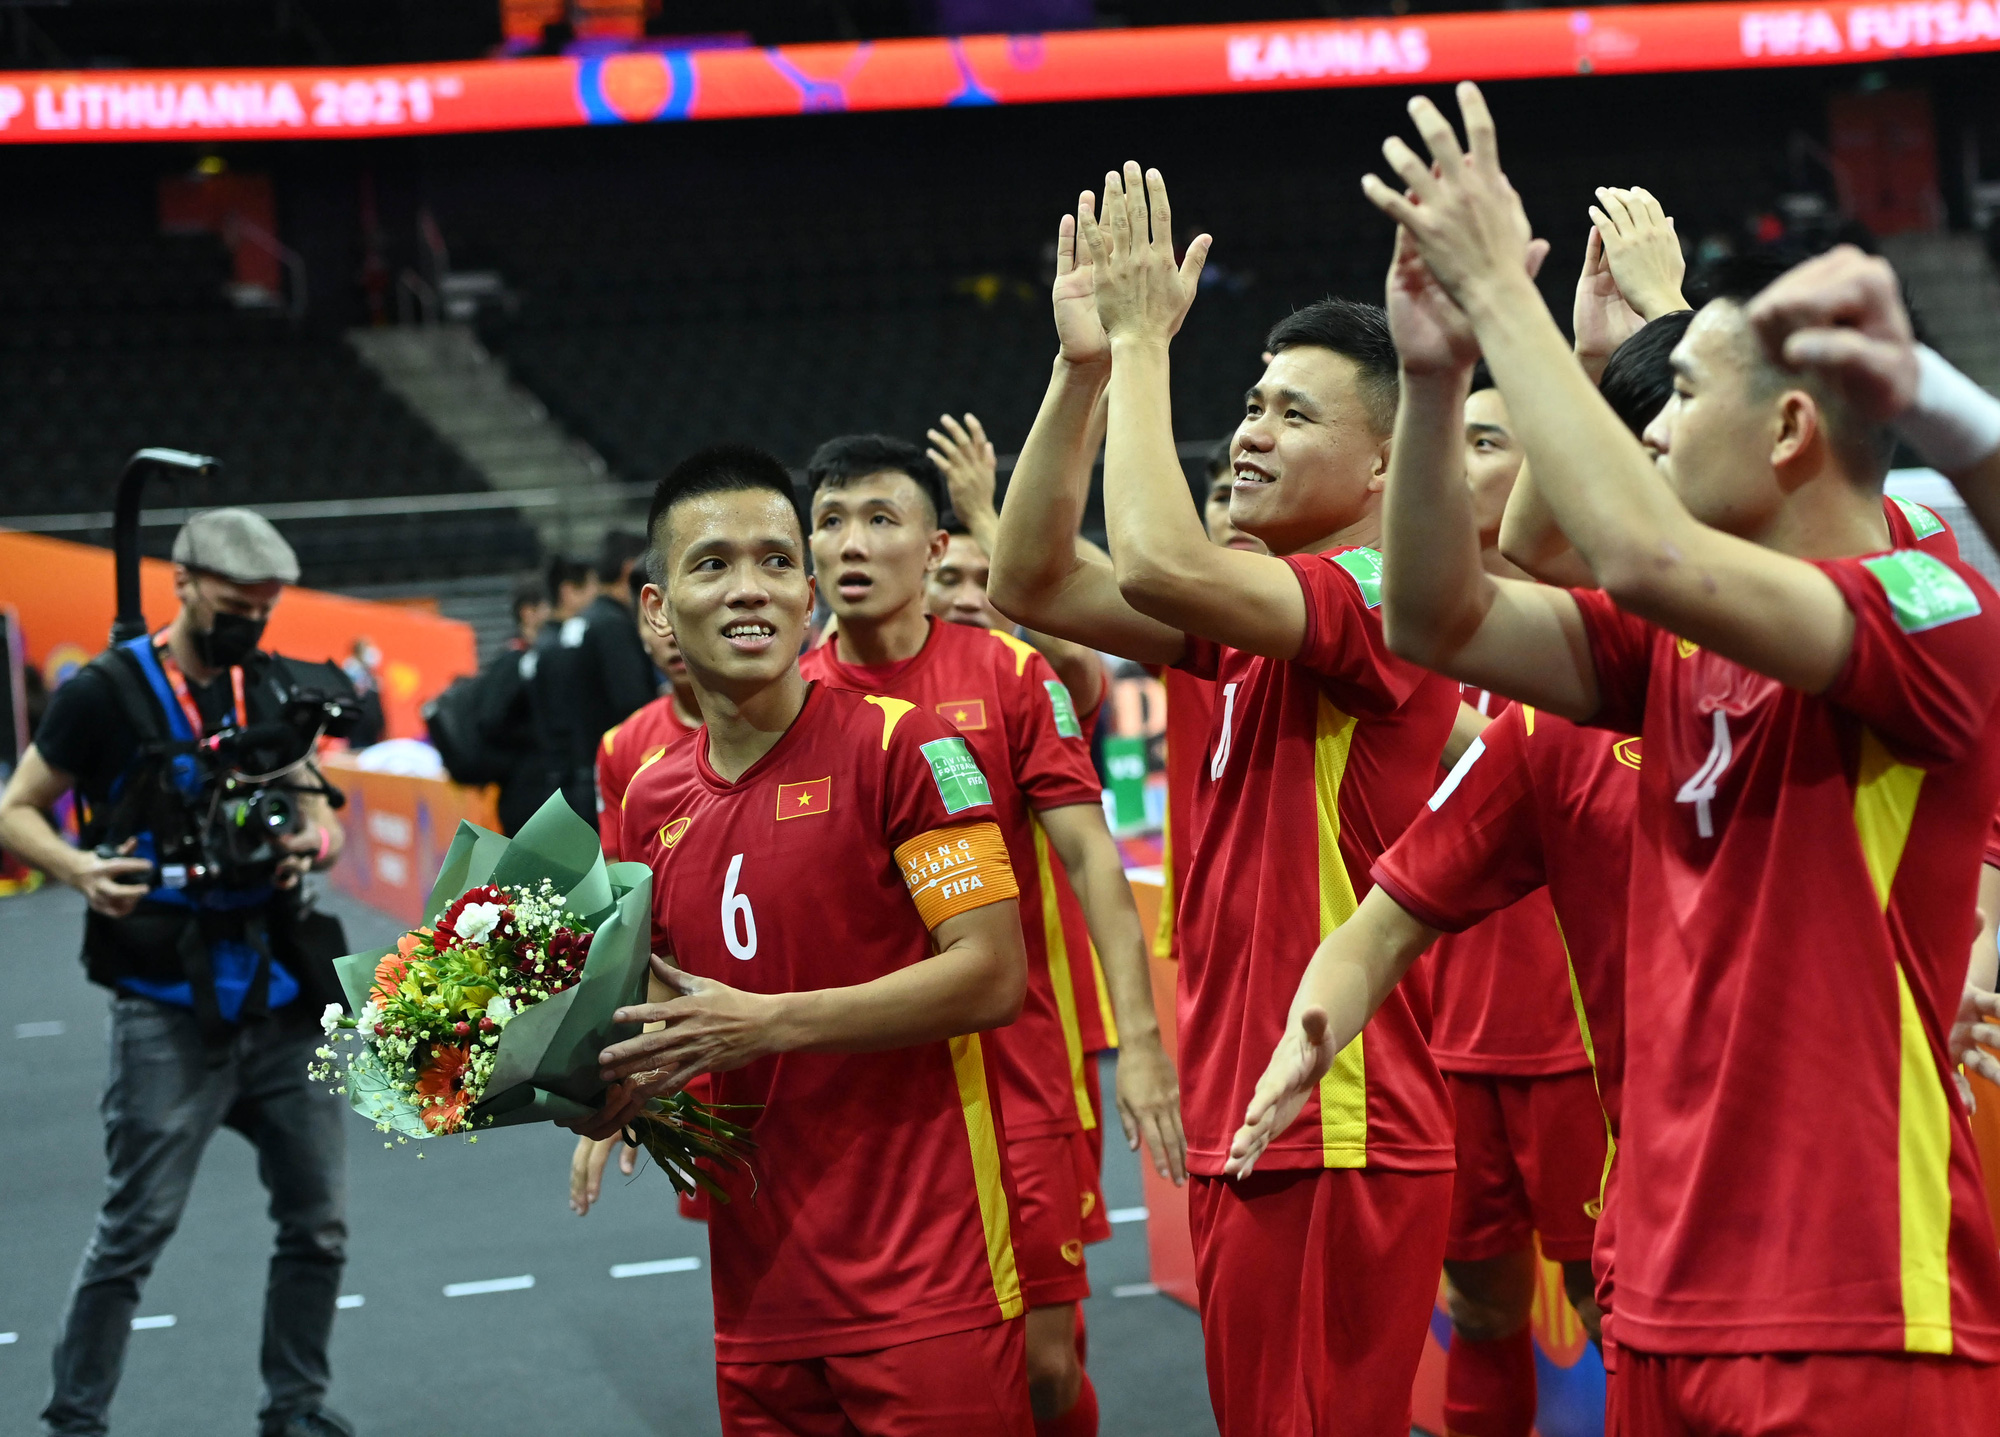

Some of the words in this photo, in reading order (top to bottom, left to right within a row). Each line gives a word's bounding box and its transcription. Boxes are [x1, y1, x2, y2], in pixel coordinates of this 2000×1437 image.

[1227, 27, 1430, 81] KAUNAS
[1740, 10, 1843, 57] FIFA
[35, 82, 304, 130] LITHUANIA
[935, 756, 973, 770] LIVING
[967, 776, 984, 786] FIFA
[1675, 709, 1733, 838] 4
[721, 853, 758, 961] 6
[941, 875, 984, 900] FIFA
